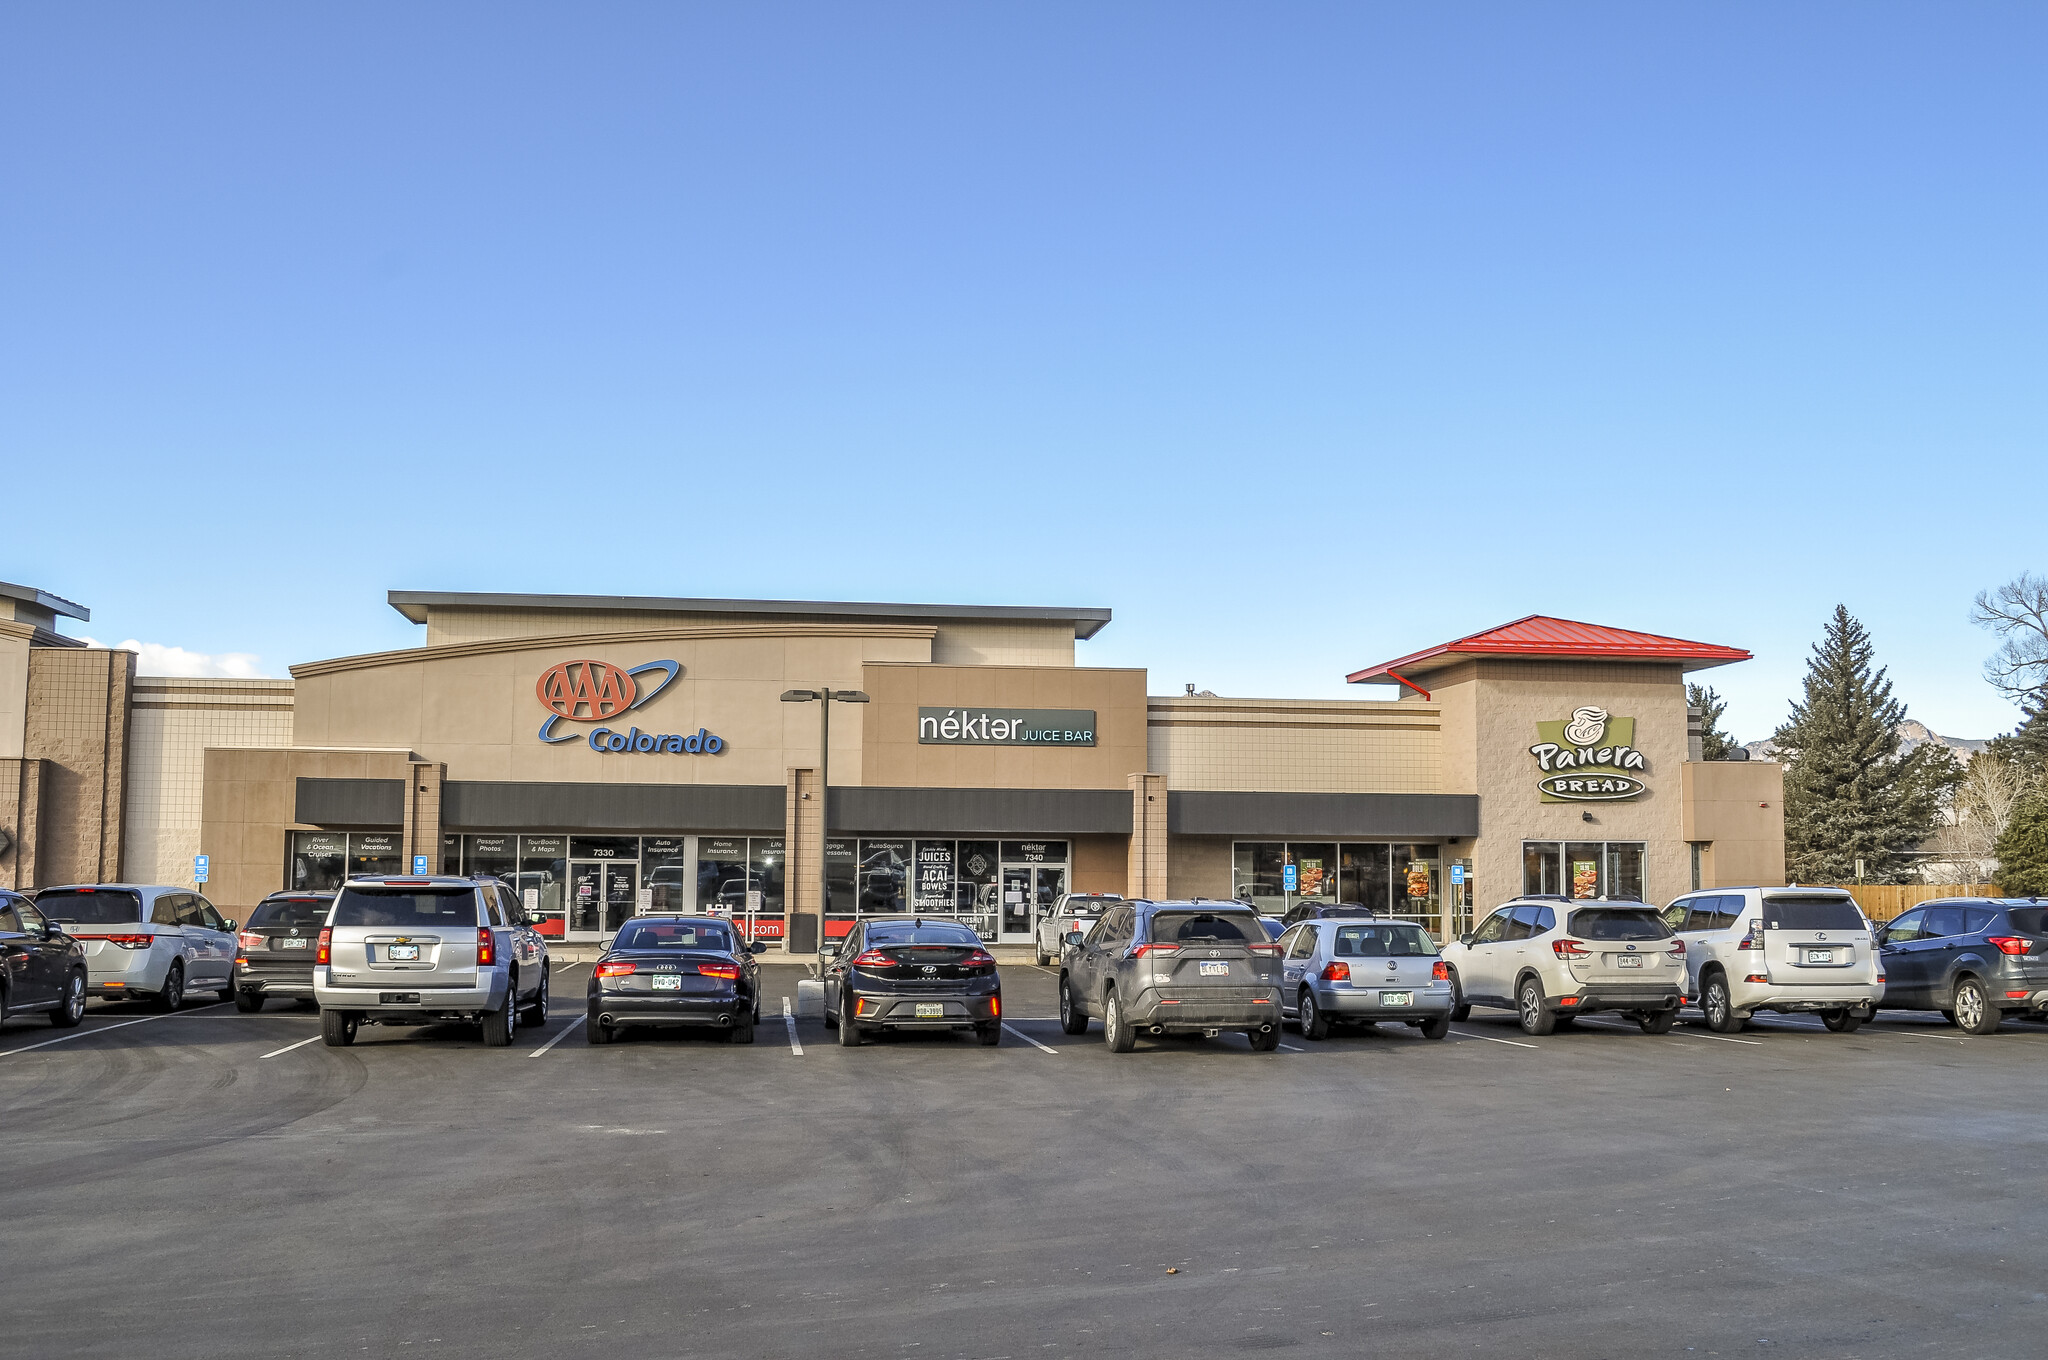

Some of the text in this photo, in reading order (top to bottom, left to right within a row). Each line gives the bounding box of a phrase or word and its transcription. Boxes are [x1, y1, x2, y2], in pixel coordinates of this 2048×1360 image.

[542, 660, 632, 719] AAA
[589, 727, 723, 754] Colorado
[1022, 730, 1059, 742] JUICE
[1064, 731, 1093, 742] BAR
[1530, 743, 1645, 771] Panera
[1554, 779, 1631, 792] BREAD
[476, 838, 505, 846] Passport
[593, 849, 614, 857] 7330
[919, 852, 951, 861] JUICES
[922, 882, 947, 890] BOWLS
[914, 899, 954, 907] SMOOTHIES
